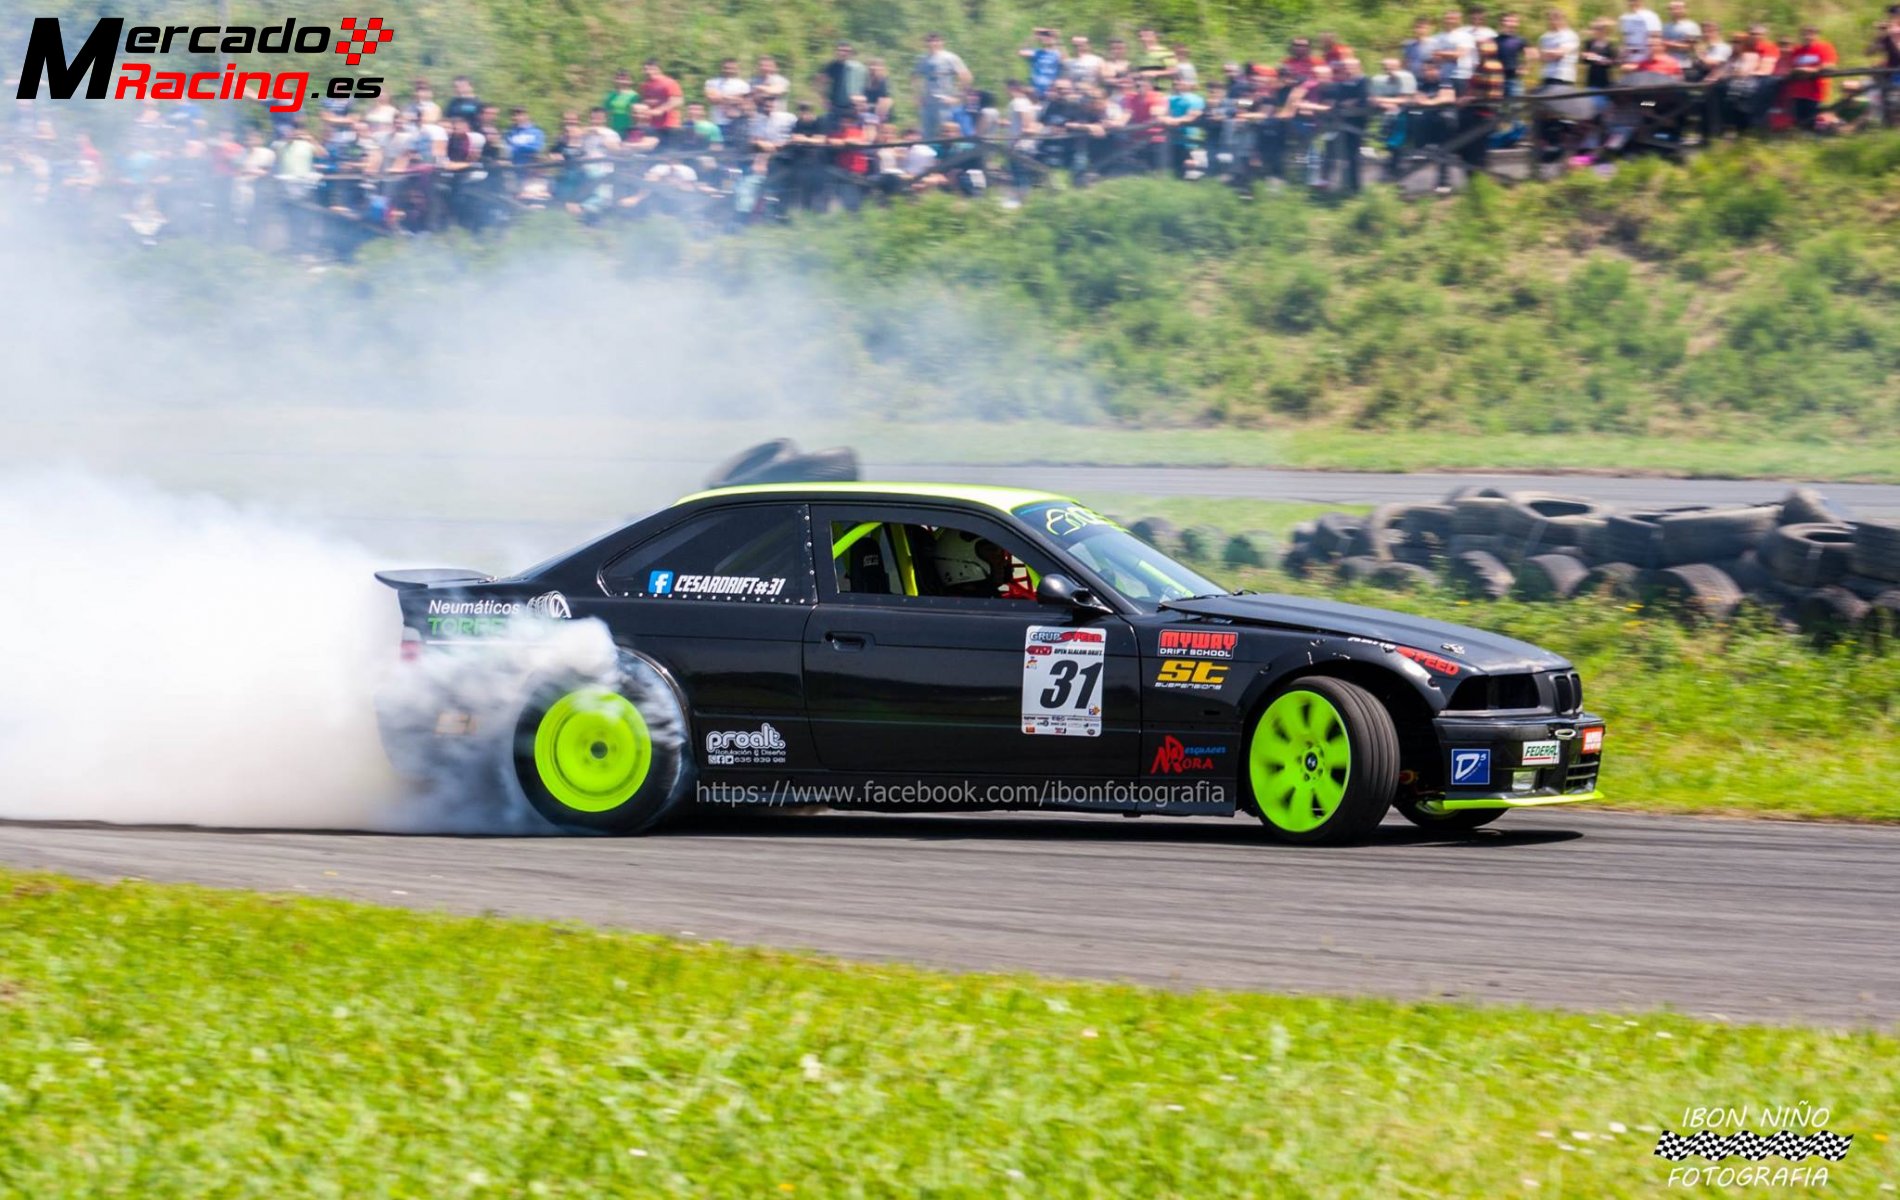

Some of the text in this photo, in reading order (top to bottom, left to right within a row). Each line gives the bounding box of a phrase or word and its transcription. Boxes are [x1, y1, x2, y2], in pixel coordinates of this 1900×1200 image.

[428, 599, 520, 615] Neumáticos
[1160, 631, 1236, 650] MYWAY
[1189, 649, 1231, 657] SCHOOL
[1039, 659, 1103, 709] 31
